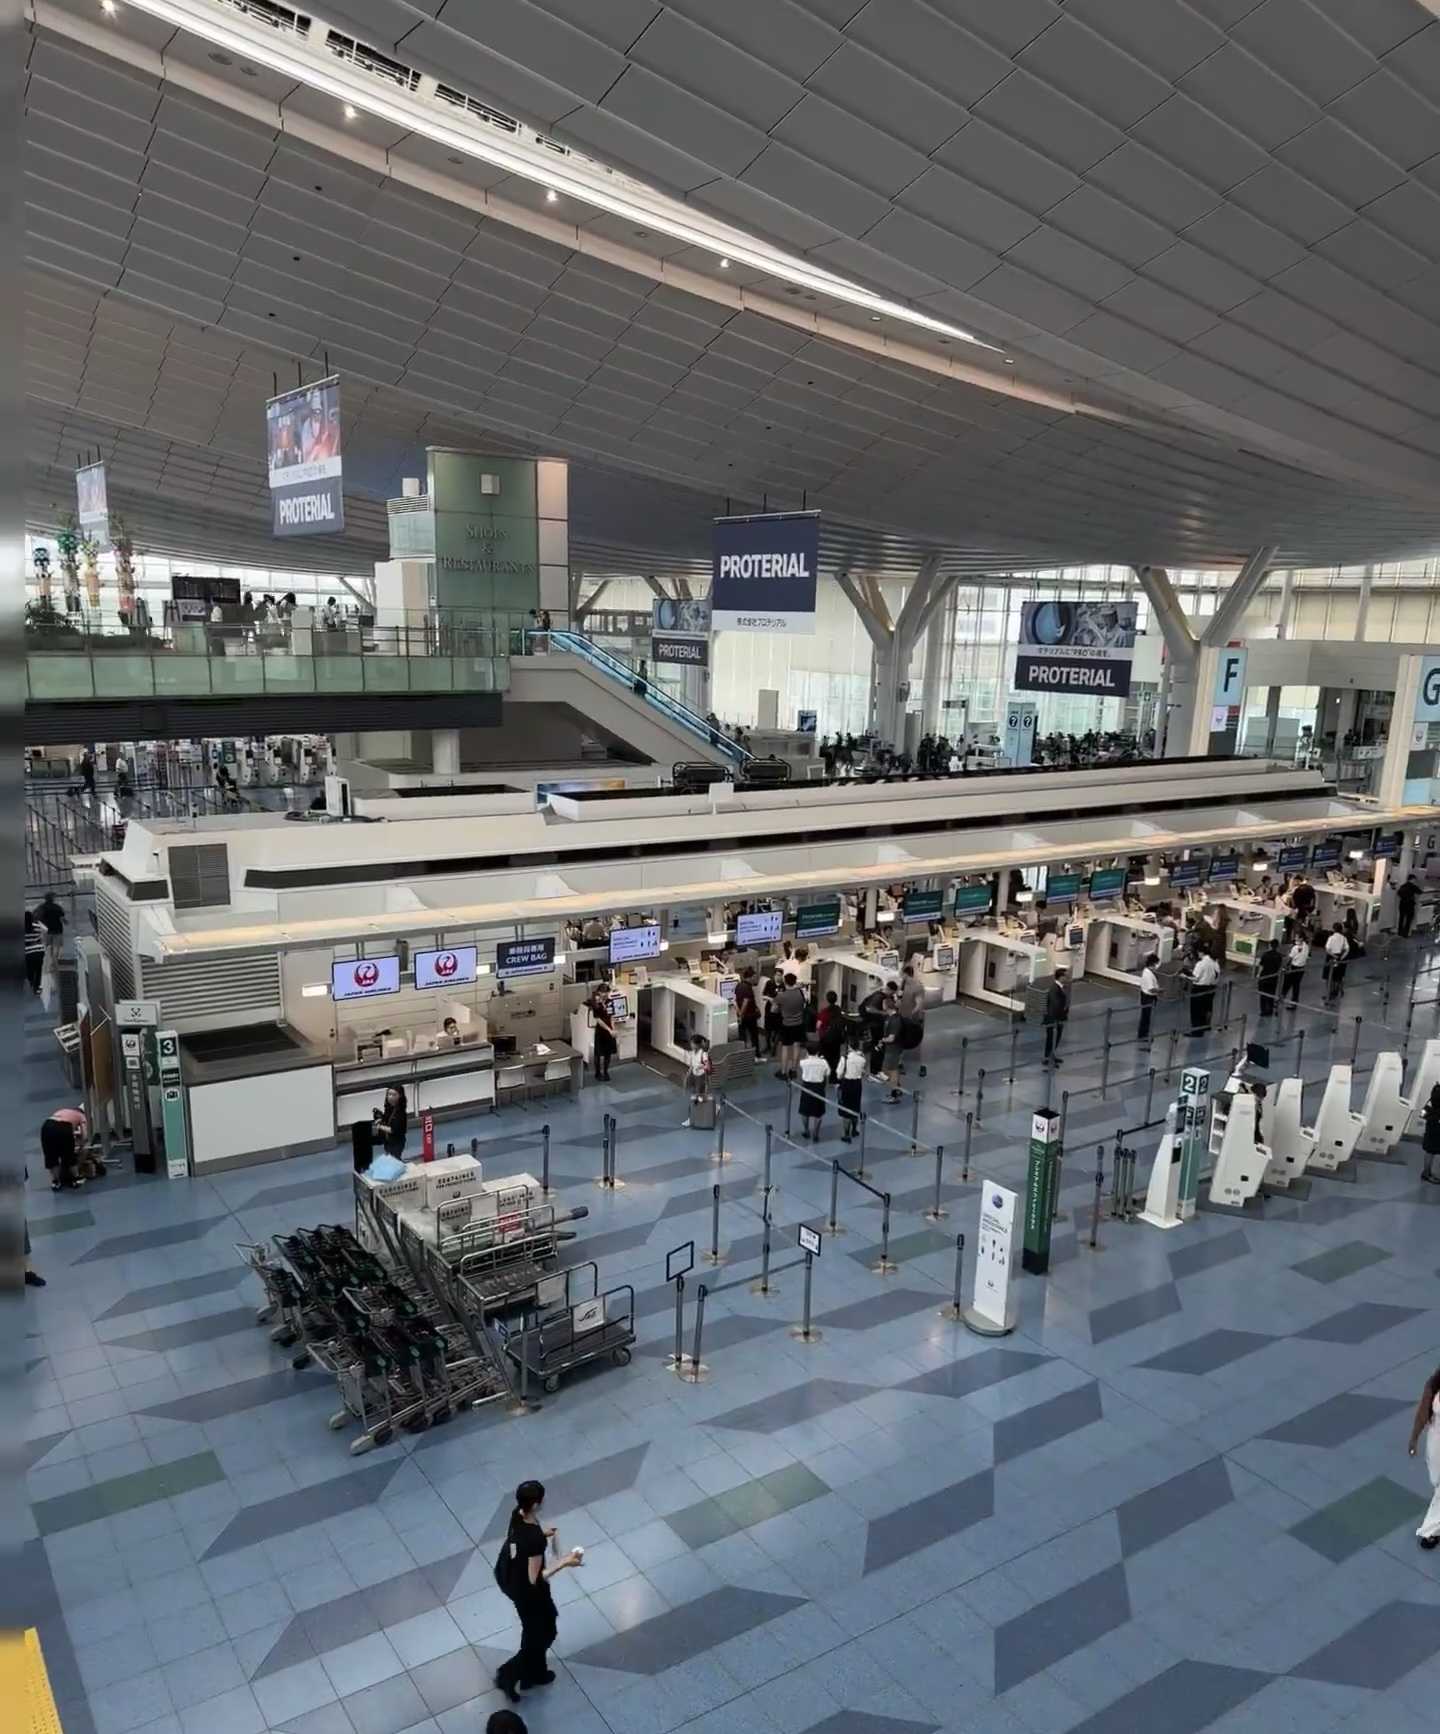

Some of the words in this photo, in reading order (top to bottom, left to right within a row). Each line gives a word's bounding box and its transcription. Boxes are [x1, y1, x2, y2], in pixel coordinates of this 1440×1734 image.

[279, 493, 335, 525] PROTERIAL
[720, 552, 810, 579] PROTERIAL
[659, 643, 702, 660] PROTERIAL
[1028, 665, 1116, 687] PROTERIAL
[1223, 658, 1239, 692] F
[1423, 667, 1440, 706] G
[505, 954, 529, 965] CREW
[530, 952, 548, 961] BAG
[163, 1040, 174, 1054] 3
[1184, 1075, 1196, 1092] 2
